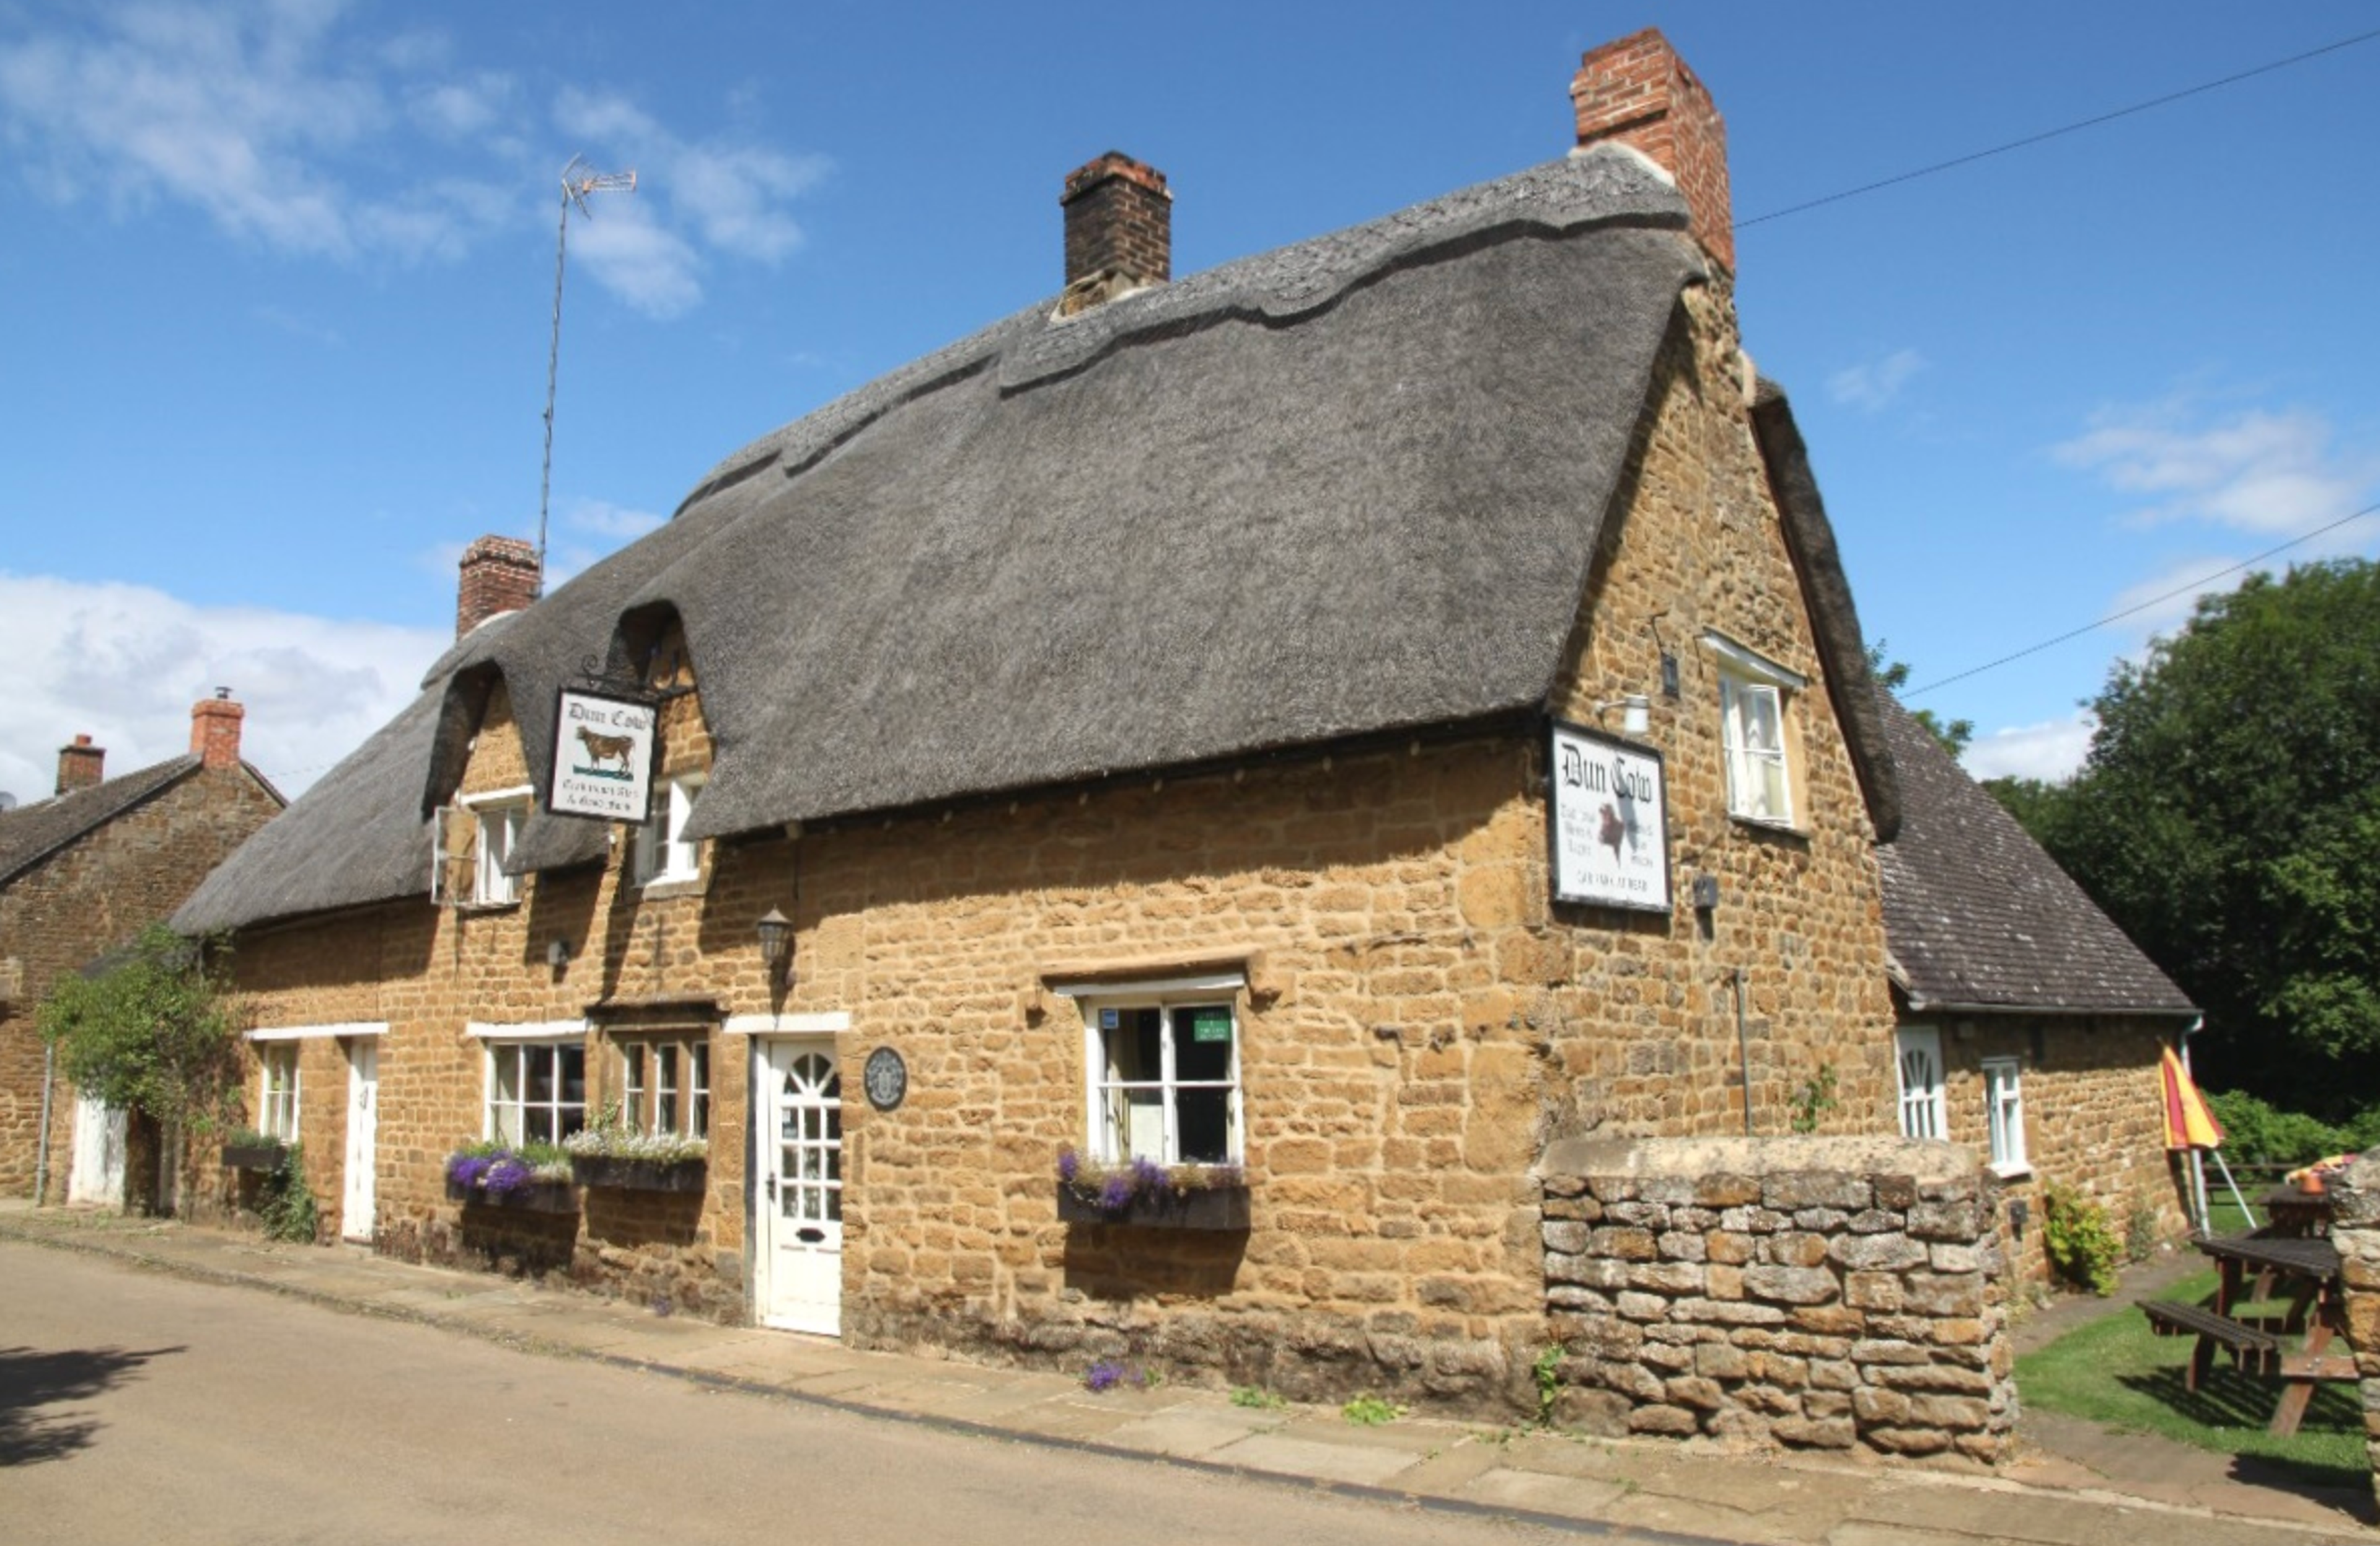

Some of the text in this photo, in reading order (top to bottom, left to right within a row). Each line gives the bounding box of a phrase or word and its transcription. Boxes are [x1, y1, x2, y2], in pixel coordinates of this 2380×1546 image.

[569, 702, 646, 730] Dun Cow
[1562, 743, 1651, 803] Dun Cow
